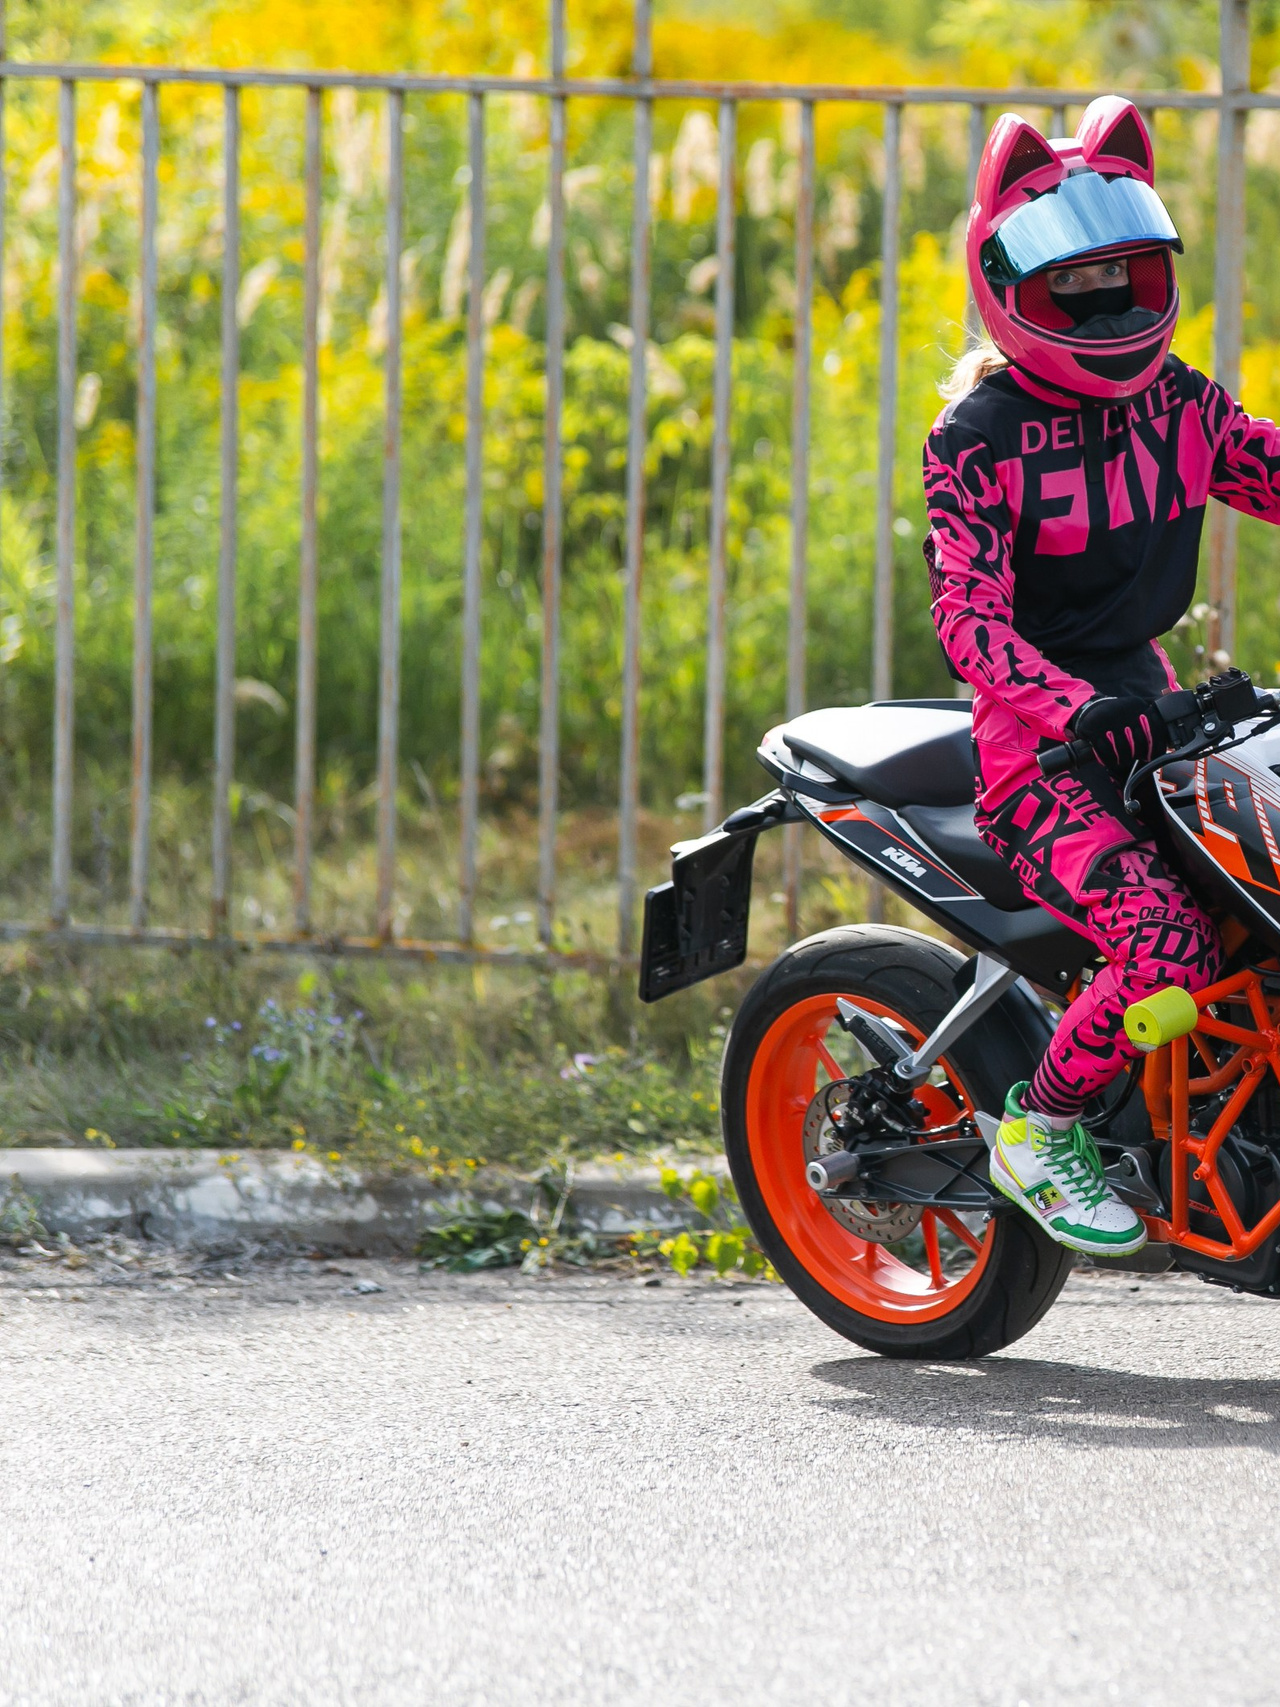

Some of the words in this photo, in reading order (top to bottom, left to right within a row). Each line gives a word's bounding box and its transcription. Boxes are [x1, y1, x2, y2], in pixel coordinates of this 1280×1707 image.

[881, 846, 927, 878] KTM
[1009, 852, 1042, 889] FOX
[1129, 920, 1215, 976] FOX
